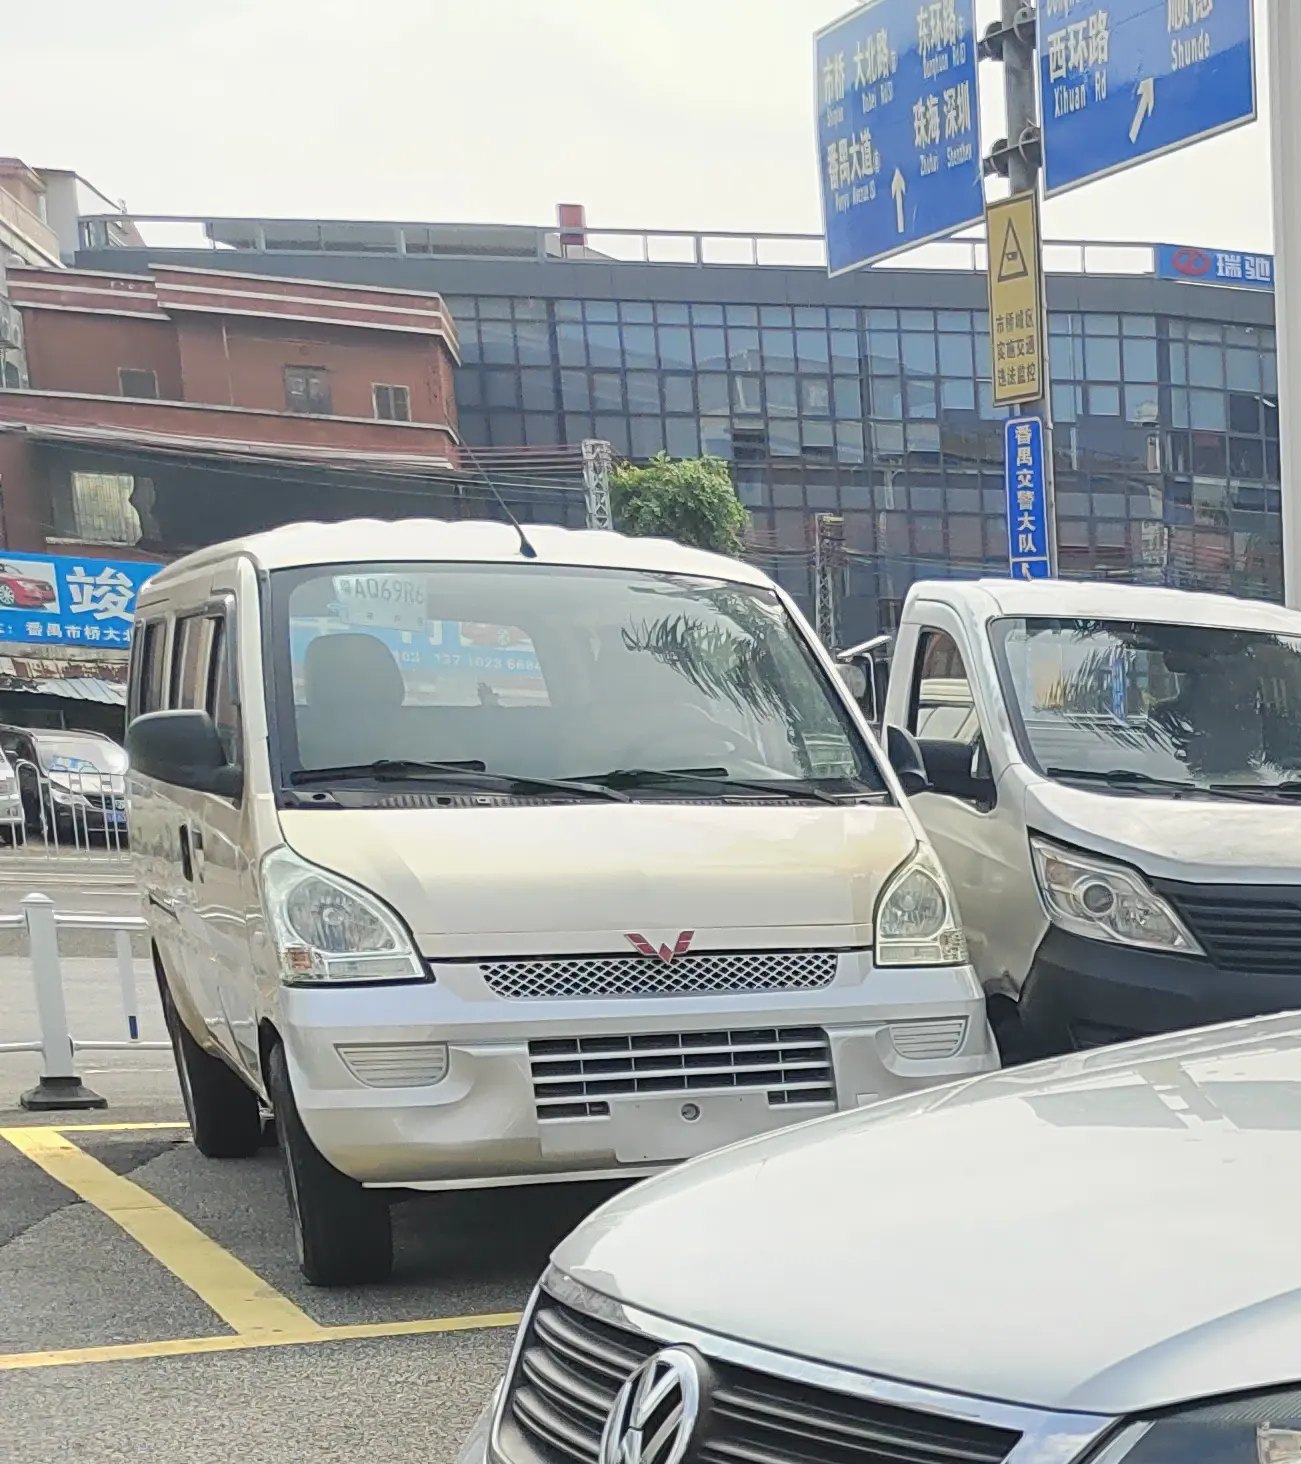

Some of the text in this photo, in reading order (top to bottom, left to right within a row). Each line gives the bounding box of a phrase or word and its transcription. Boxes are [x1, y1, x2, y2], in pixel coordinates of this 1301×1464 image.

[1048, 9, 1109, 83] 西环路
[1171, 28, 1210, 71] Shunde
[913, 80, 971, 149] 珠海 深圳
[1053, 70, 1107, 119] Xihuan Rd
[1215, 253, 1271, 282] 瑞驰
[1015, 424, 1037, 553] 番禺交警大队
[65, 566, 136, 623] 竣
